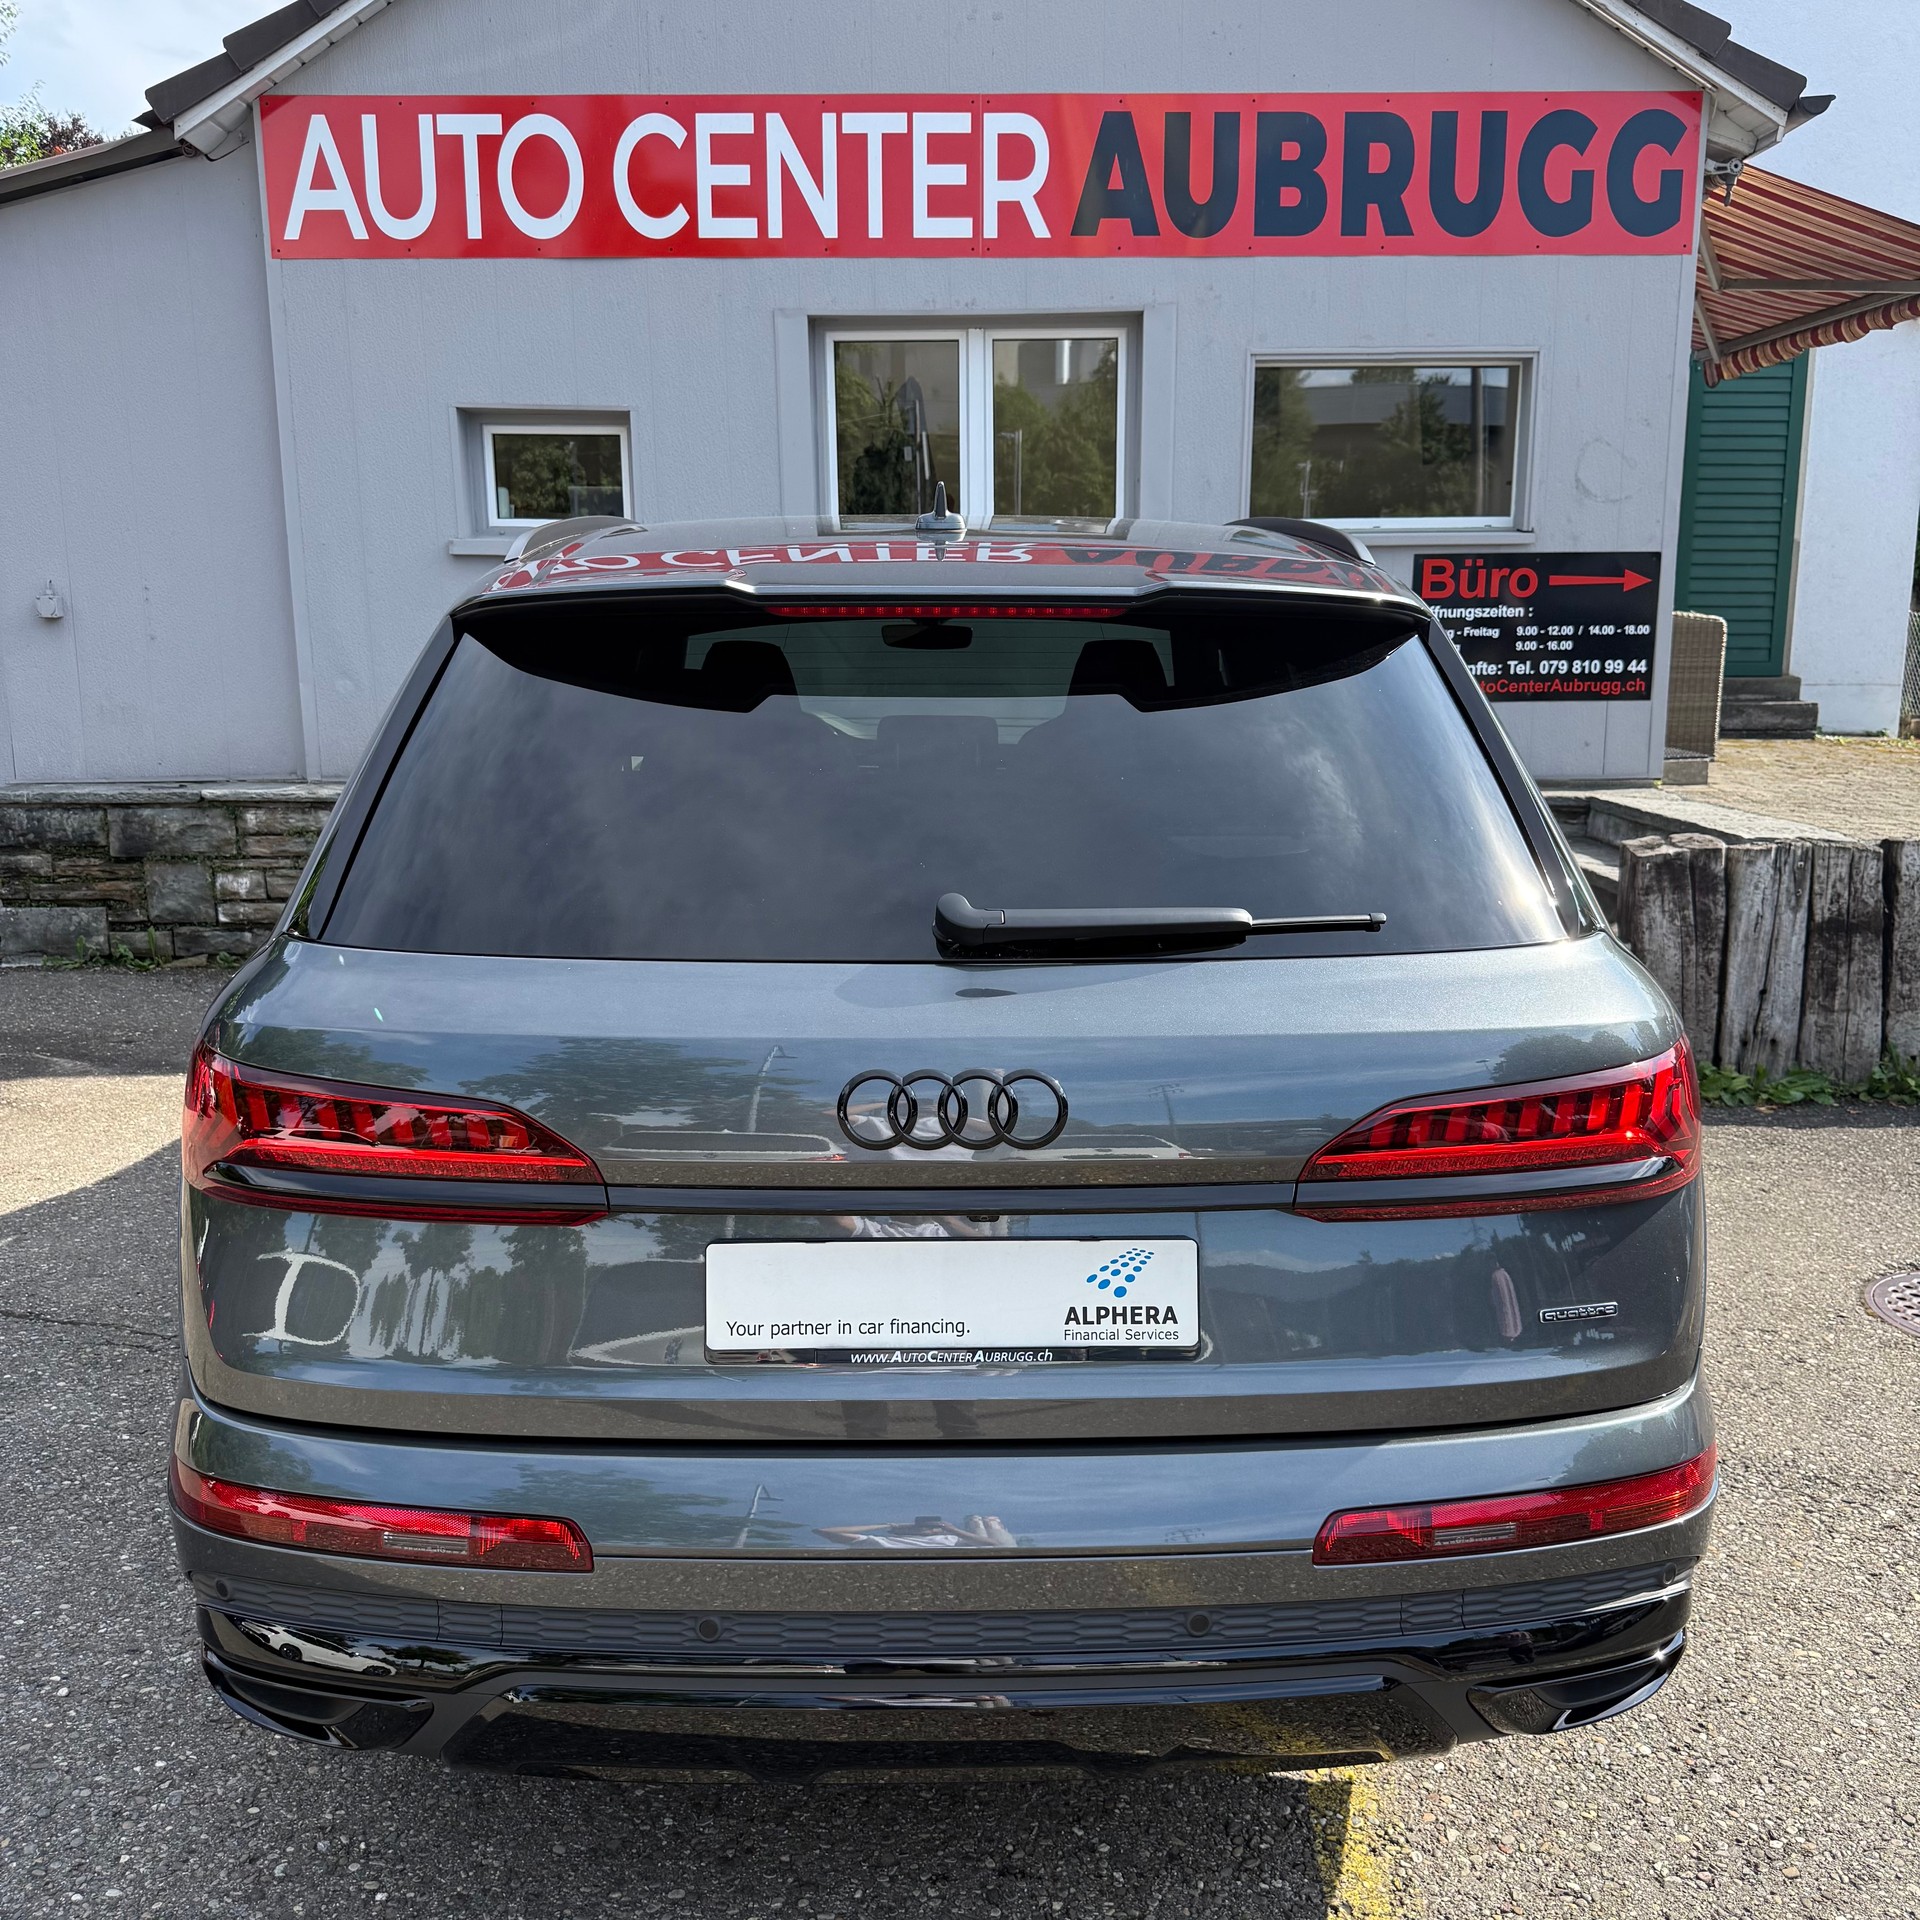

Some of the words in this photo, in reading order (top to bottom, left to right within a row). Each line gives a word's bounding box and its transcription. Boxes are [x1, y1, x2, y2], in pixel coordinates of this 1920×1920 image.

[284, 112, 585, 241] AUTO
[613, 111, 1051, 241] CENTER
[1070, 109, 1688, 239] AUBRUGG
[1421, 558, 1539, 599] Büro
[1430, 605, 1525, 621] ffnungszeiten
[1463, 626, 1500, 639] Freitag
[1516, 625, 1539, 636] 9.00
[1547, 625, 1575, 636] 12.00
[1588, 624, 1615, 636] 14.00
[1624, 624, 1651, 635] 18.00
[1515, 640, 1538, 651] 9.00
[1546, 640, 1574, 651] 16.00
[1468, 661, 1504, 676] nfte:
[1507, 660, 1536, 675] Tel.
[1539, 660, 1569, 675] 079
[1571, 660, 1601, 674] 810
[1604, 660, 1624, 674] 99
[1627, 659, 1648, 674] 44
[1480, 678, 1647, 695] toCenterAubrugg.ch
[1063, 1305, 1179, 1326] ALPHERA
[1544, 1304, 1616, 1321] quattro
[726, 1321, 765, 1336] Your
[770, 1320, 832, 1339] partner
[838, 1319, 852, 1335] in
[858, 1320, 885, 1335] car
[890, 1318, 971, 1337] financing.
[1064, 1328, 1120, 1341] Financial
[1125, 1328, 1179, 1341] Services
